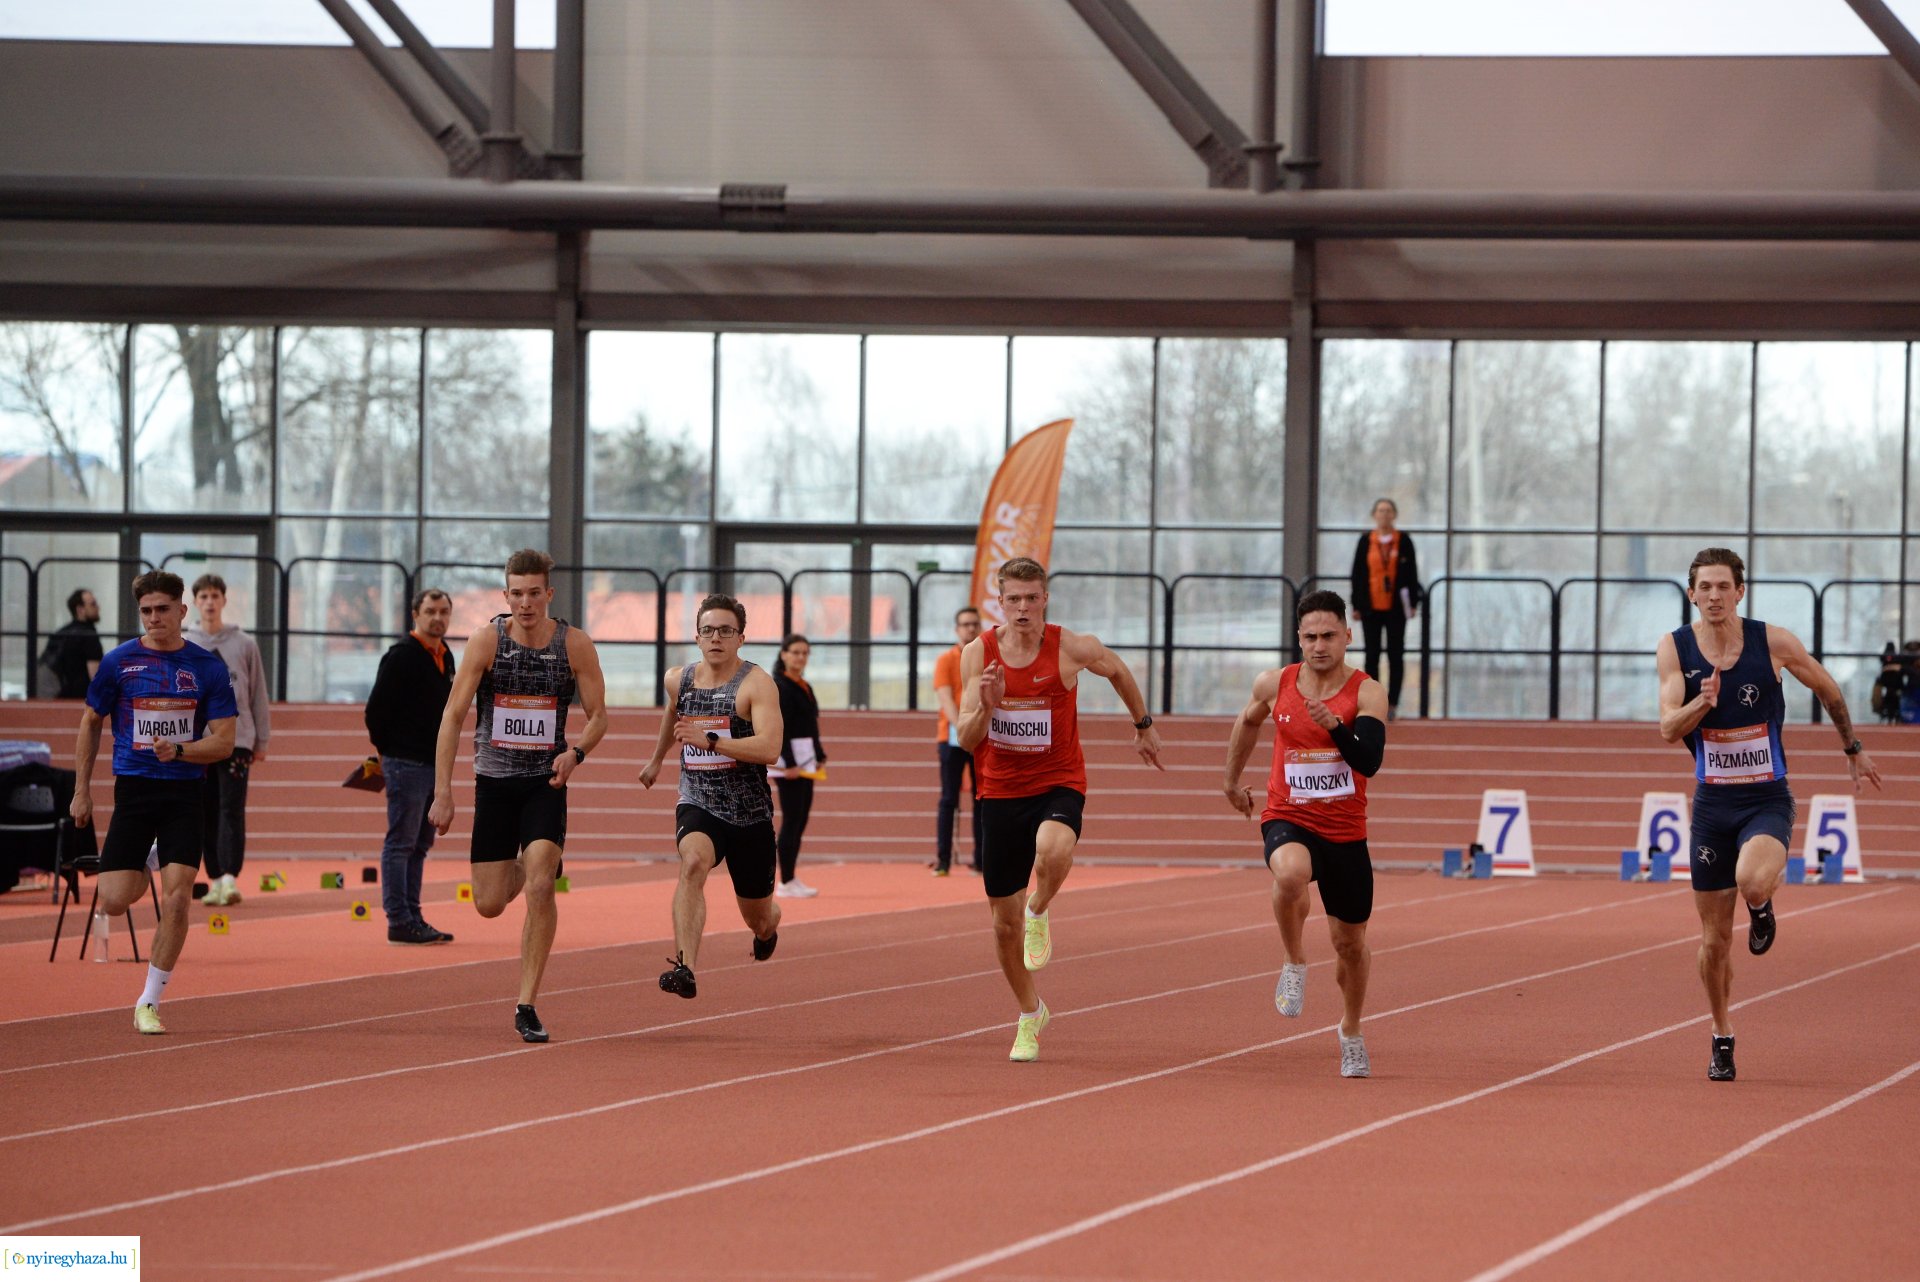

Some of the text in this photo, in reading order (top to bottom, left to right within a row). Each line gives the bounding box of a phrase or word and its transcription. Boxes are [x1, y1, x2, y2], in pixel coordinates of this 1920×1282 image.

[982, 501, 1021, 632] AGYAR
[138, 718, 191, 737] VARGA M.
[504, 718, 545, 737] BOLLA
[992, 717, 1048, 737] BUNDSCHU
[1708, 748, 1770, 769] PÁZMÁNDI
[1289, 771, 1349, 791] ILLOVSZKY
[1489, 806, 1520, 854] 7
[1649, 809, 1681, 857] 6
[1818, 812, 1849, 858] 5
